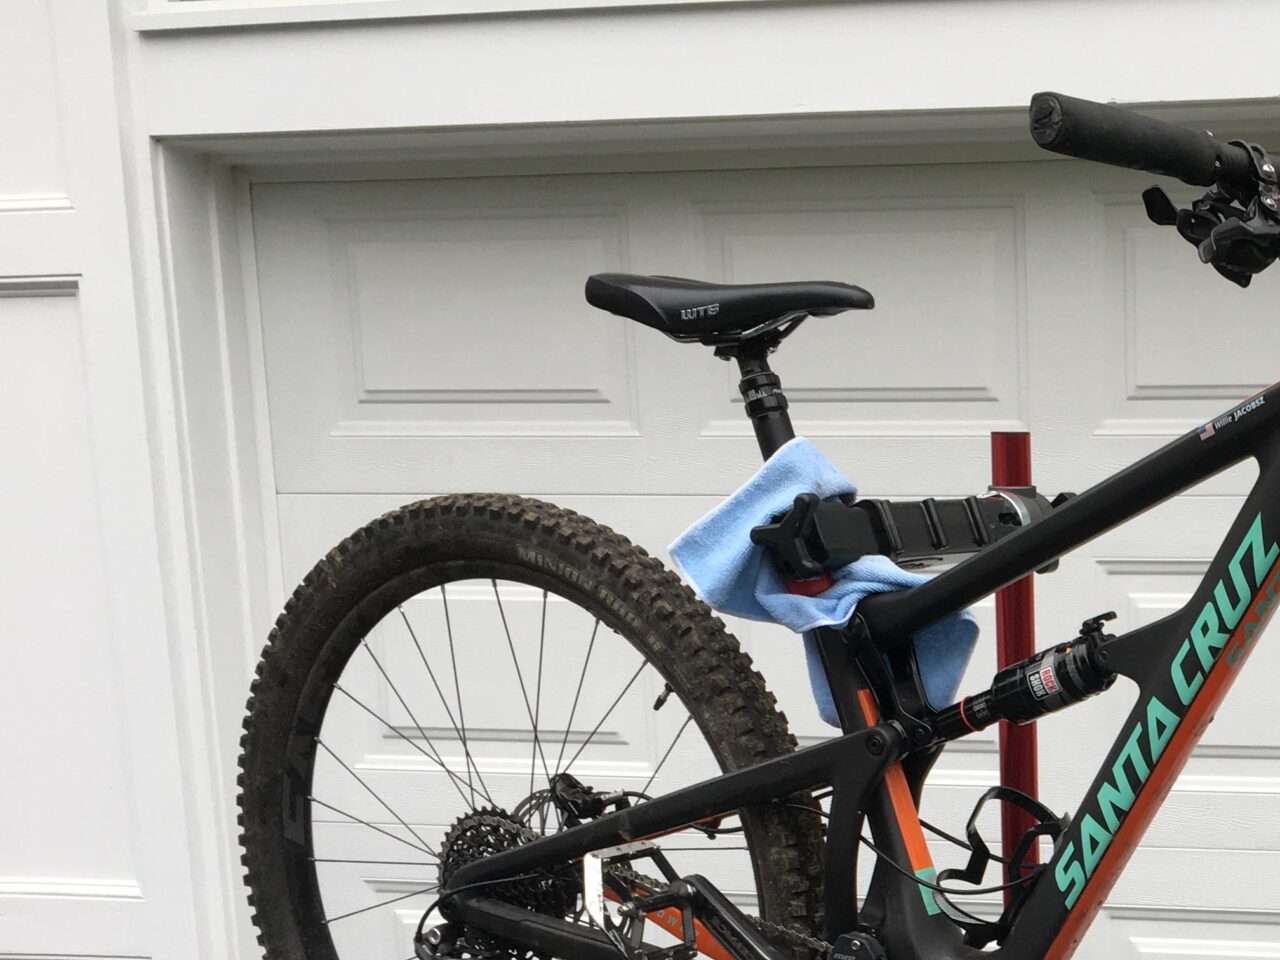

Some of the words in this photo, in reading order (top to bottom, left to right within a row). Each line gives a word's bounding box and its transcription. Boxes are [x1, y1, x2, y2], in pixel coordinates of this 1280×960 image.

[1233, 395, 1266, 422] JACOBSZ
[1042, 667, 1059, 693] ROCK
[1055, 696, 1181, 910] SANTA
[1170, 511, 1280, 707] CRUZ
